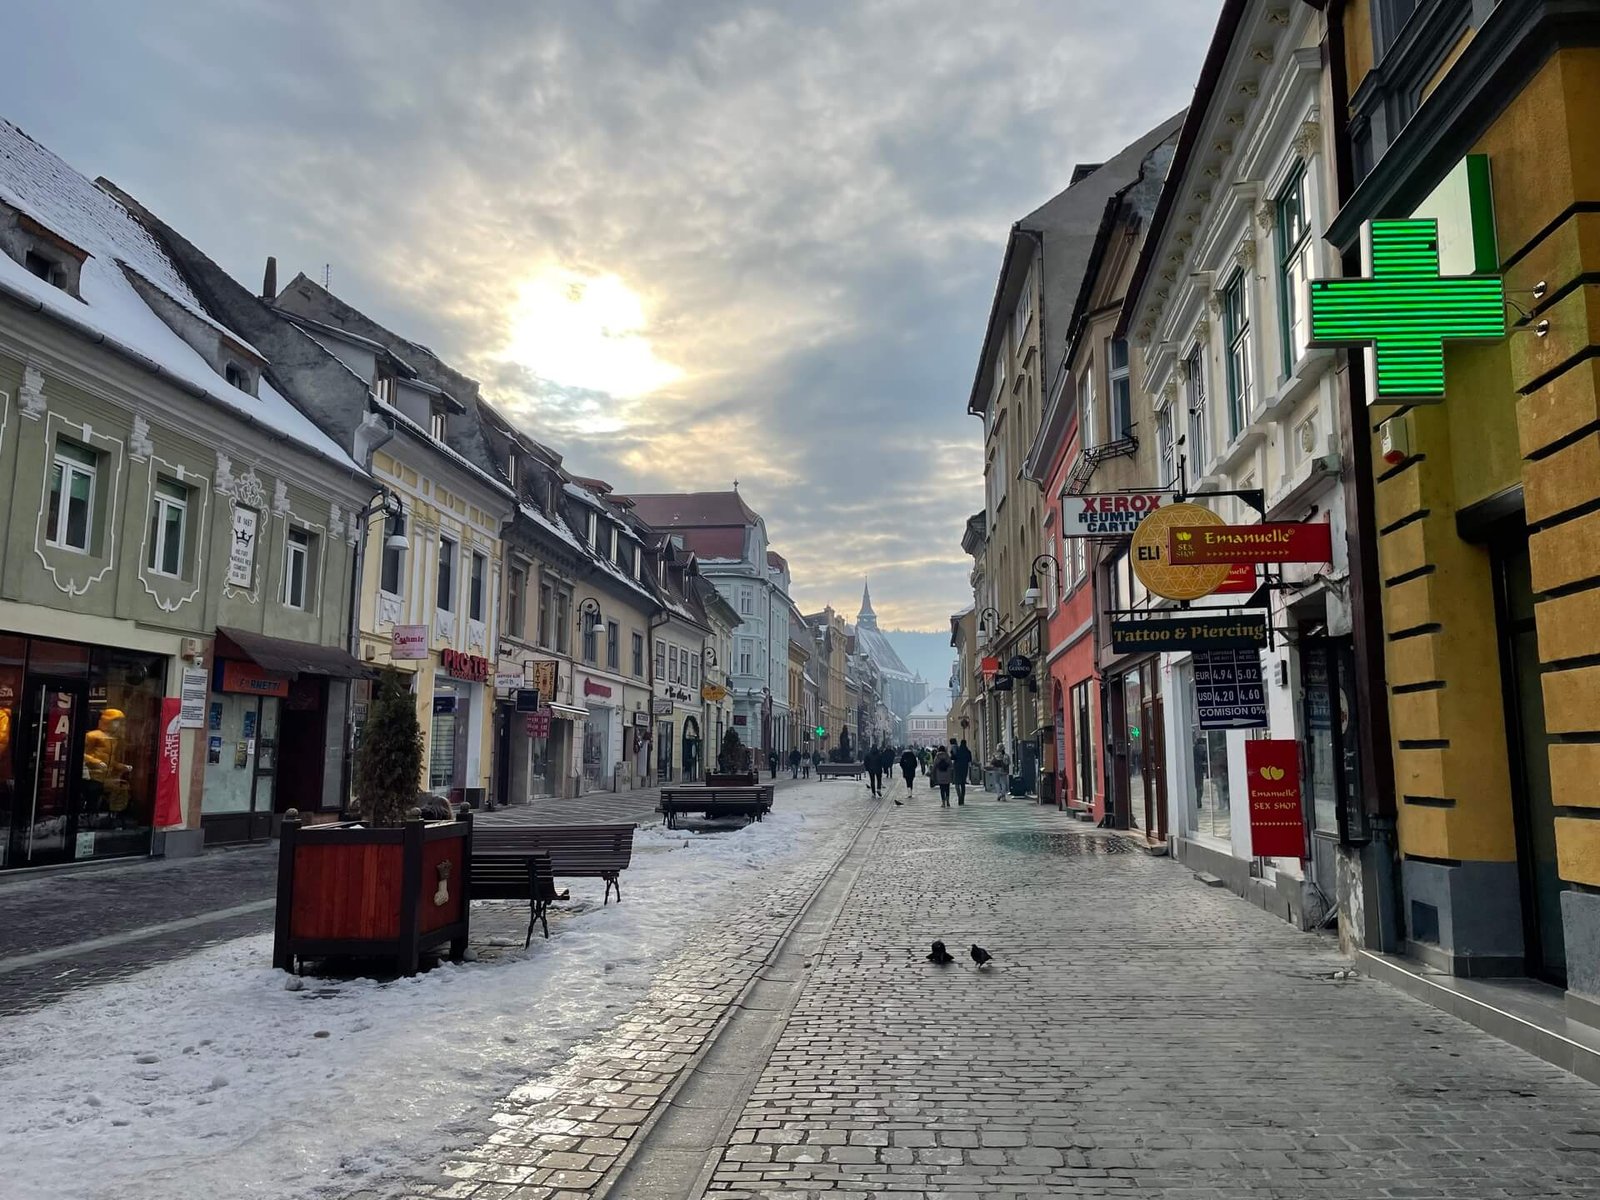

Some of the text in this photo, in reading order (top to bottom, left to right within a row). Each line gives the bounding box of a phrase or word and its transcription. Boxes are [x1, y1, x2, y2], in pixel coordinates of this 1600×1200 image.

[1082, 495, 1161, 513] XEROX
[1178, 543, 1193, 551] SEX
[1138, 546, 1160, 561] ELI
[1114, 623, 1264, 642] Tattoo & Piercing
[1195, 669, 1258, 680] EUR 4.94 5.02
[1198, 689, 1260, 702] USD 4.20 4.60
[1200, 706, 1266, 717] COMISION 0%
[1254, 802, 1297, 810] SEX SHOP
